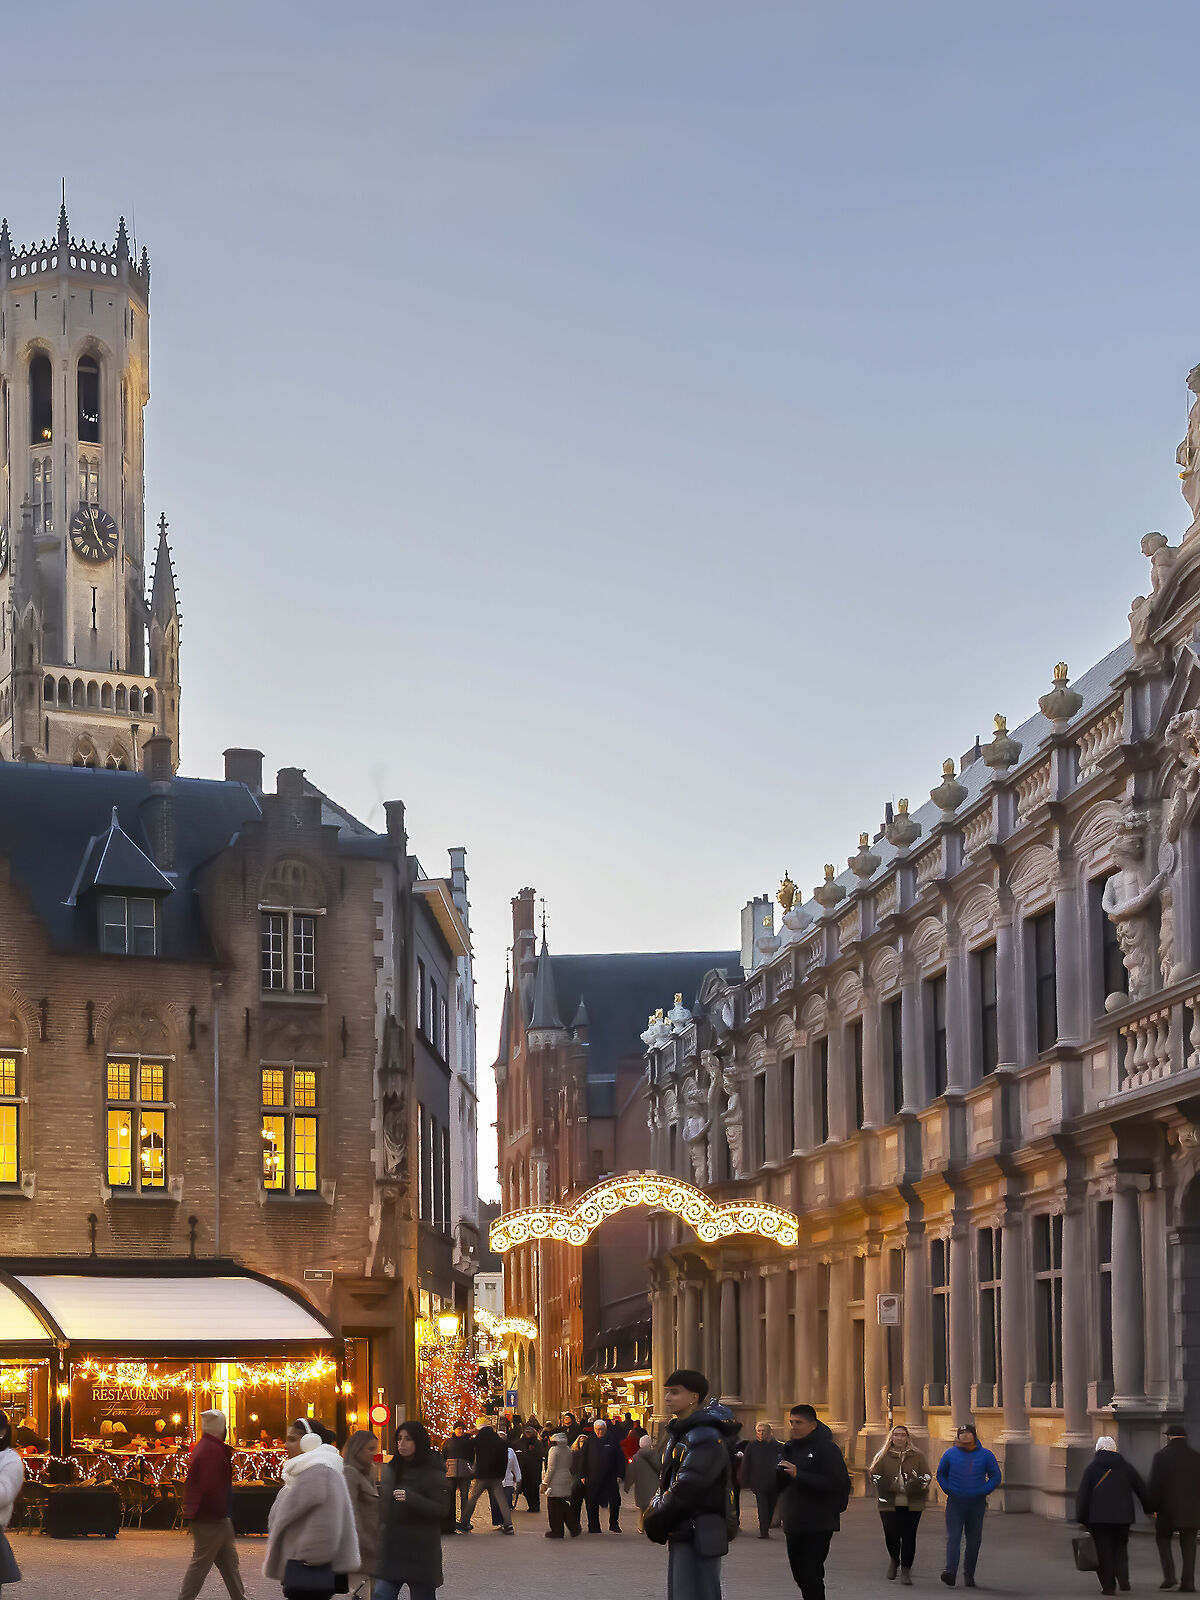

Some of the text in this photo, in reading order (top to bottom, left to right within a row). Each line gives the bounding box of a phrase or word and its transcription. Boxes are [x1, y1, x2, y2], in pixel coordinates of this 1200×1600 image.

[92, 1388, 172, 1401] RESTAURANT
[101, 1401, 161, 1416] Tom Pouce
